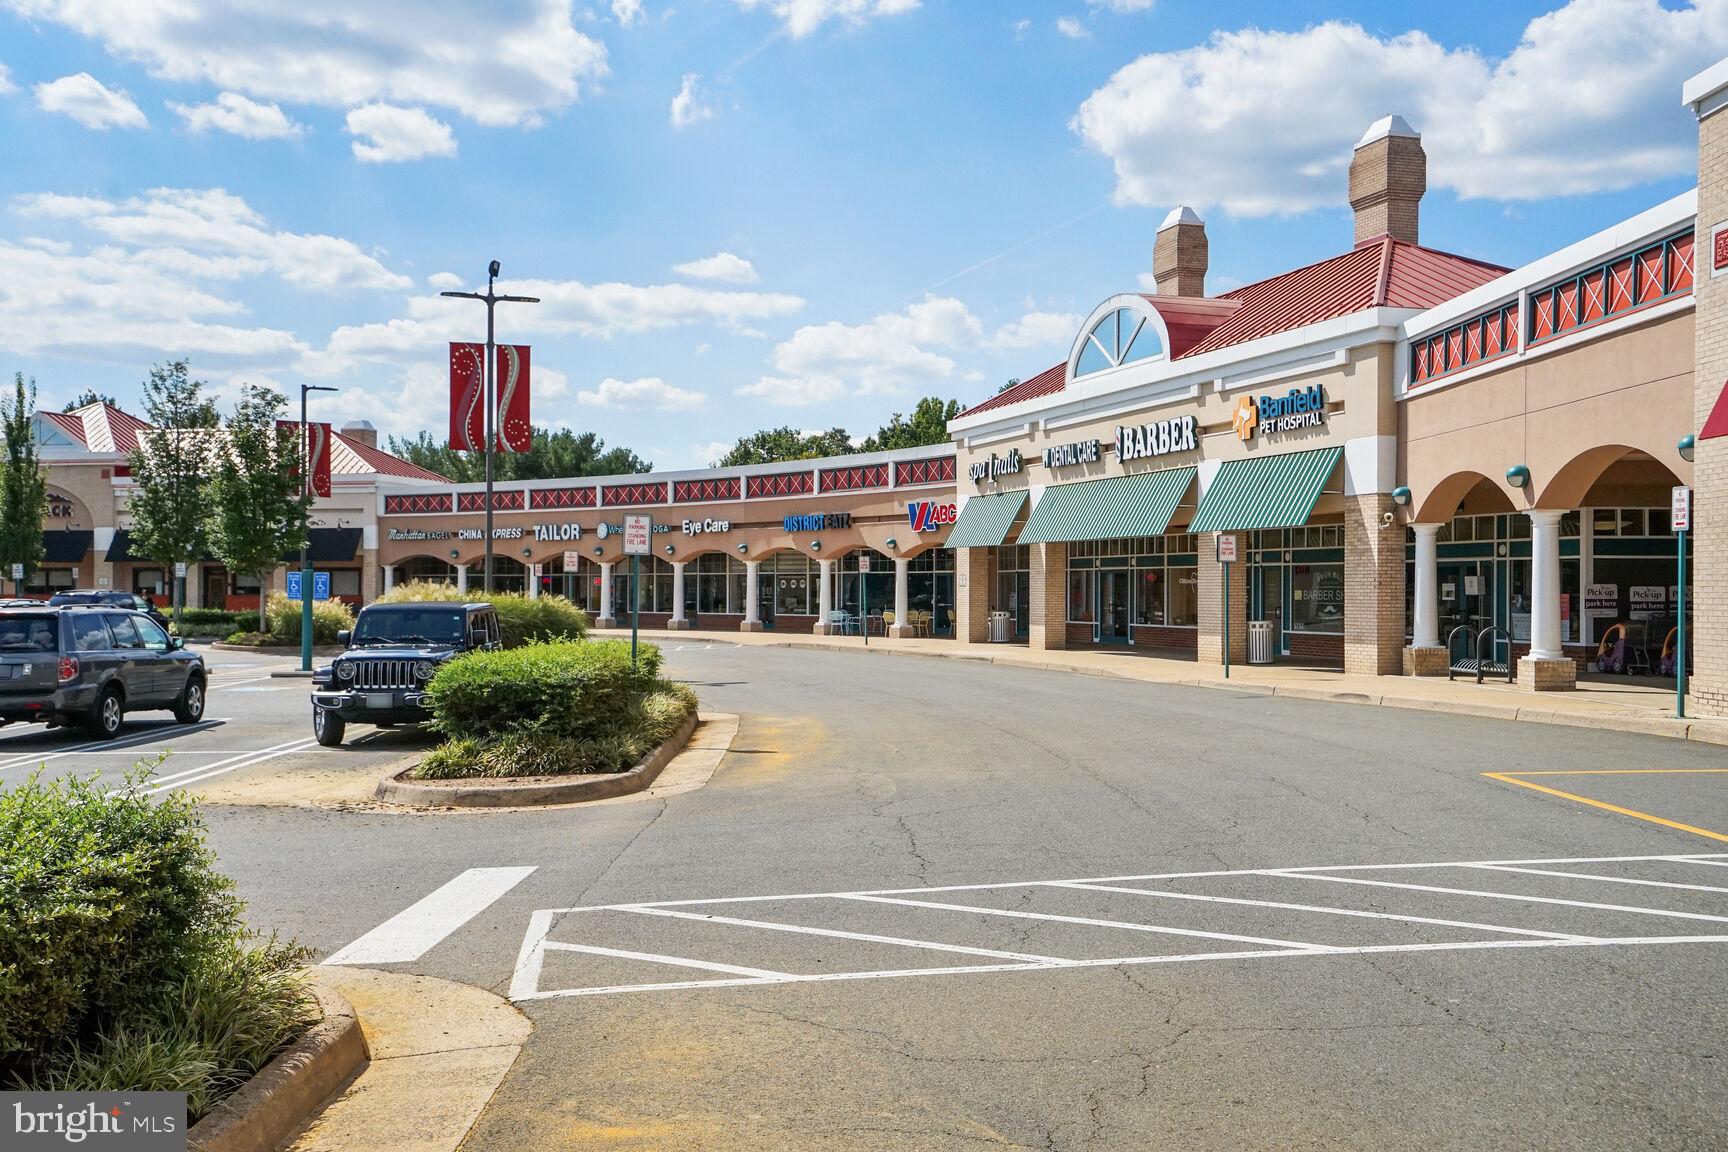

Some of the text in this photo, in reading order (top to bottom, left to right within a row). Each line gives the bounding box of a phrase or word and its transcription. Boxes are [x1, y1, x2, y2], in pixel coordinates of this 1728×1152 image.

[1259, 384, 1323, 419] Banfield
[1260, 411, 1323, 434] PET HOSPITAL
[1122, 415, 1197, 460] BARBER
[1050, 440, 1098, 468] DENTAL CARE
[968, 461, 986, 484] spa
[994, 449, 1021, 476] nails
[783, 512, 850, 532] DISTRICT EATZ
[930, 503, 958, 525] ABC
[388, 528, 427, 540] Manhattan
[458, 529, 482, 540] CHINA
[532, 524, 580, 541] TAILOR
[652, 525, 669, 533] OGA
[682, 518, 730, 536] Eye Care
[1303, 589, 1333, 601] BARBER
[1631, 602, 1648, 610] park
